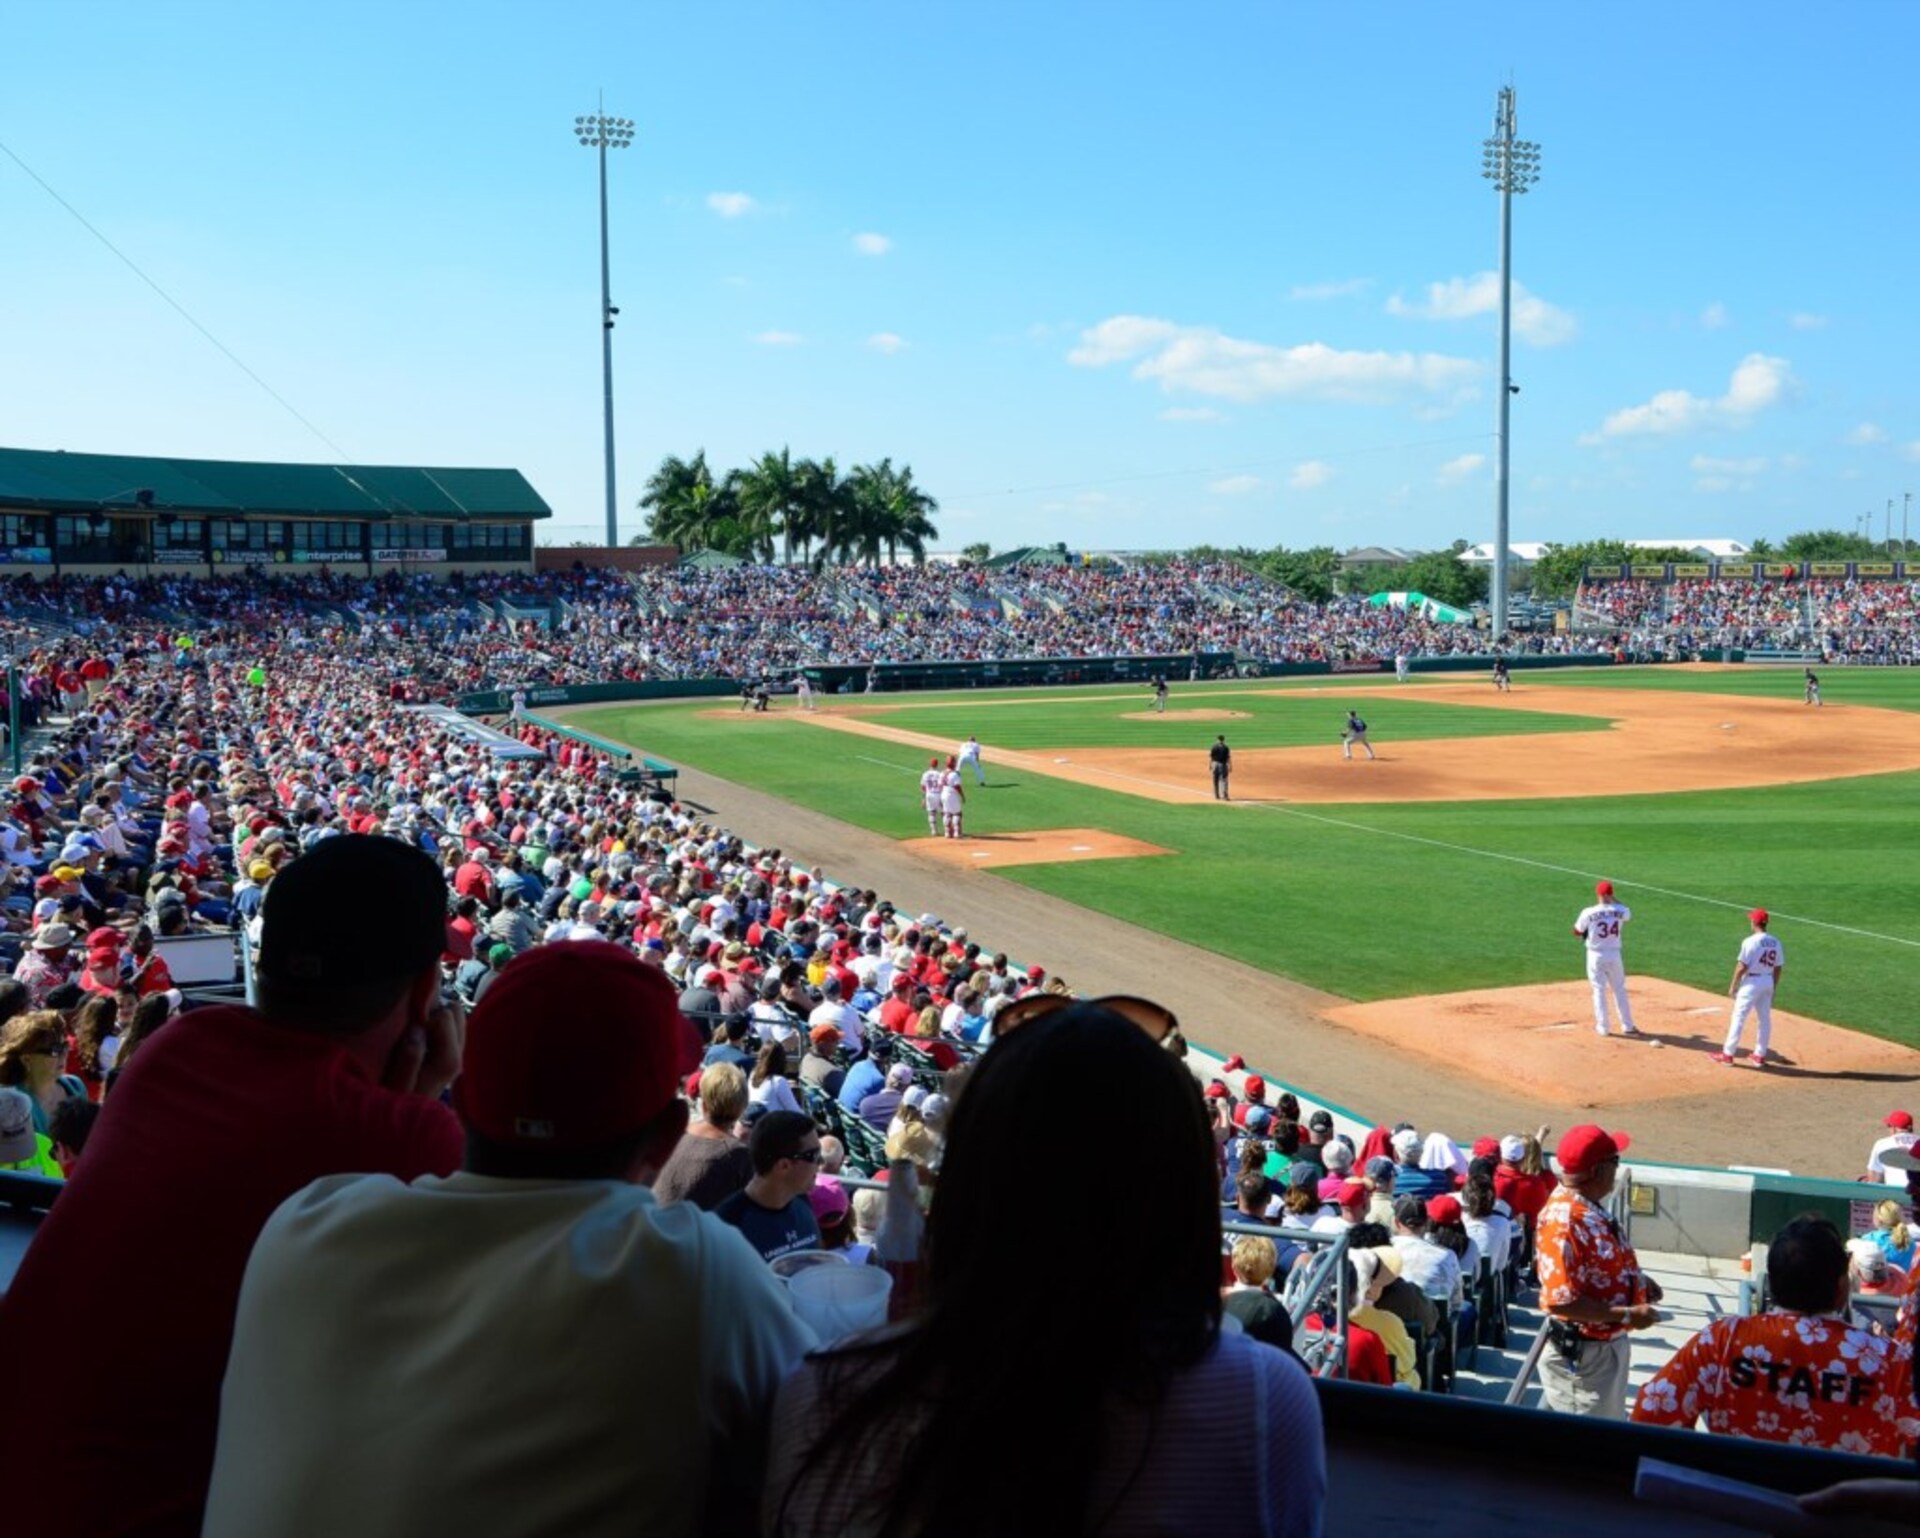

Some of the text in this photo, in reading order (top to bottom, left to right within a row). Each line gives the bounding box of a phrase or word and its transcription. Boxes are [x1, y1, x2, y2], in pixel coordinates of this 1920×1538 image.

[1597, 920, 1619, 938] 34
[1758, 949, 1777, 967] 49
[1730, 1356, 1877, 1406] STAFF
